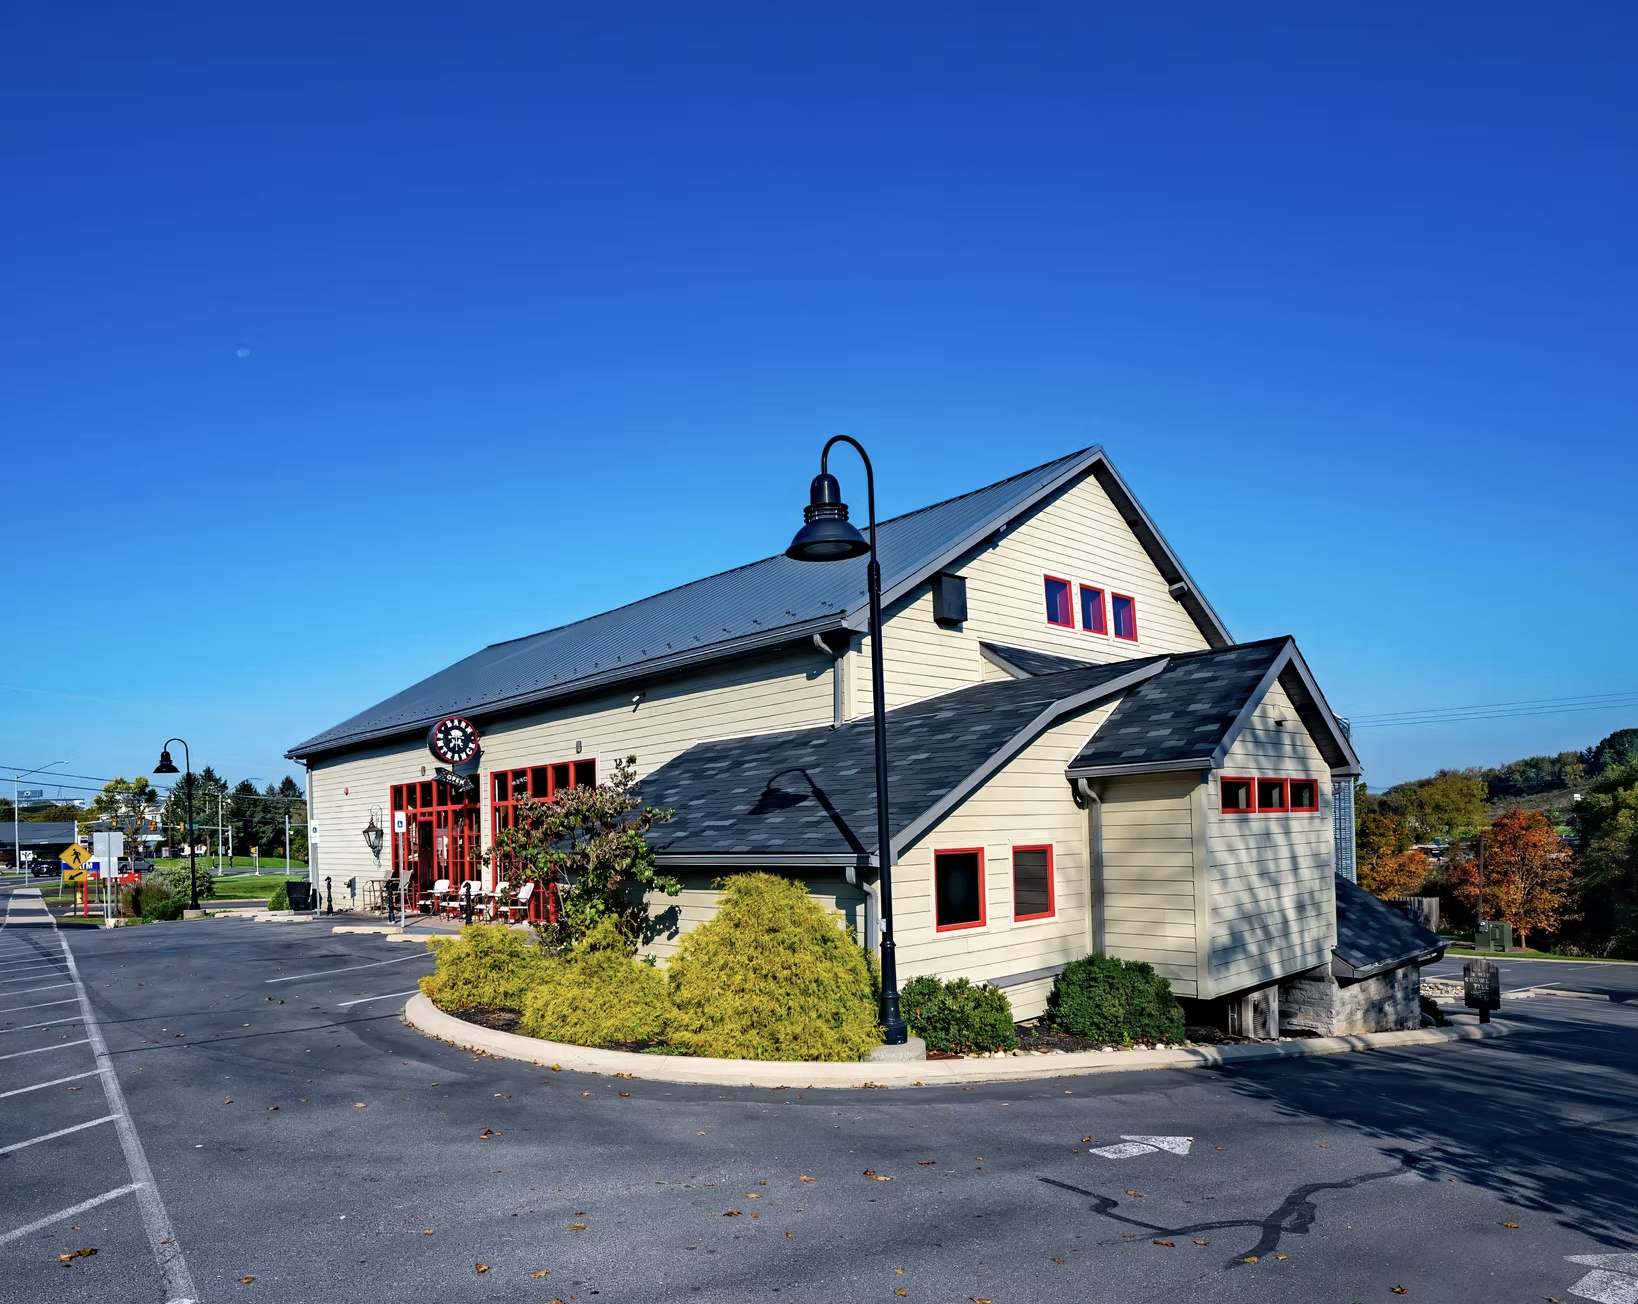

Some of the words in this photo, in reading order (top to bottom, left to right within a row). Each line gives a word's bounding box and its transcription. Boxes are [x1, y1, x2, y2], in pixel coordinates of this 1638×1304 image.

[445, 719, 473, 734] BARN
[437, 733, 475, 761] ENTRANCE
[446, 774, 465, 785] OPEN
